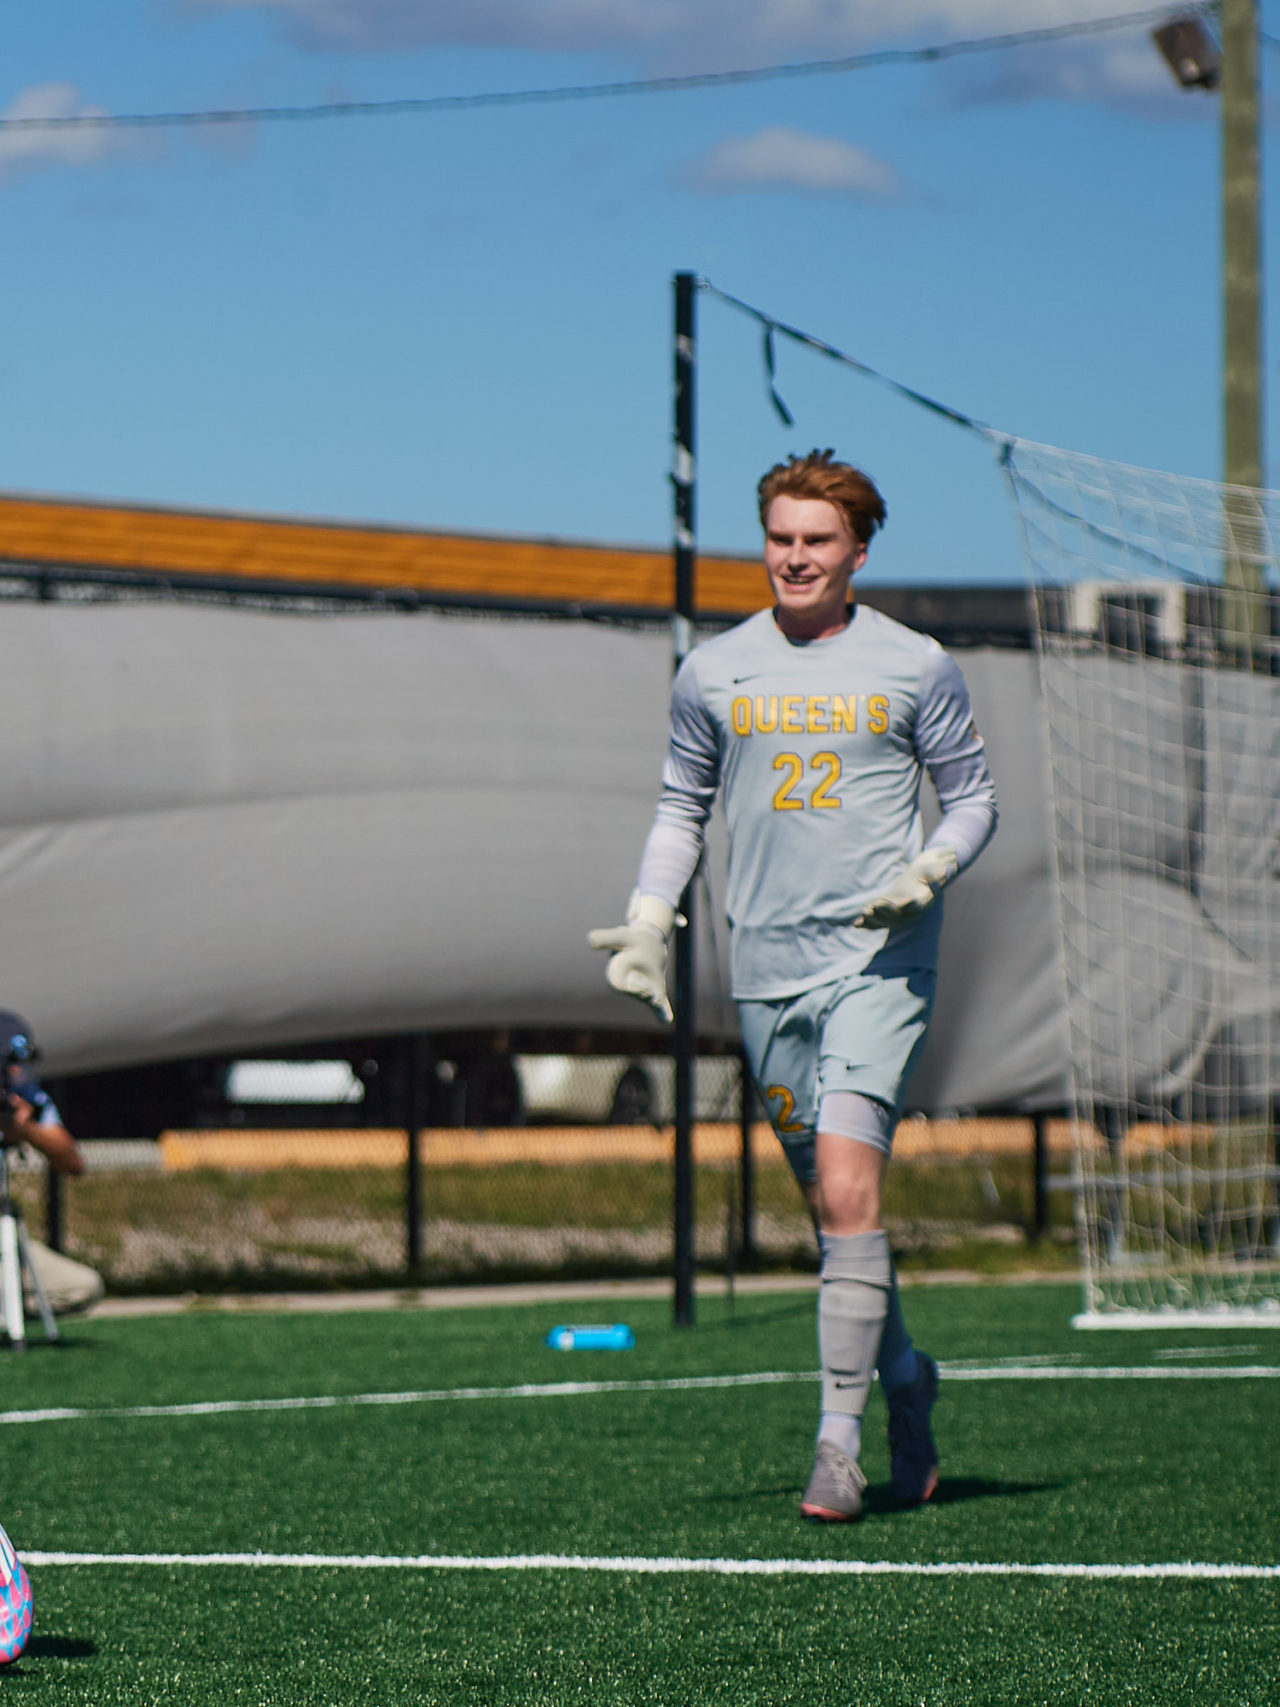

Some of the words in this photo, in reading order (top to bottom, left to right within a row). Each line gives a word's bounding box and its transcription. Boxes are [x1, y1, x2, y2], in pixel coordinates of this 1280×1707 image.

[731, 693, 890, 737] QUEEN'S
[772, 751, 842, 811] 22
[767, 1085, 805, 1133] 2
